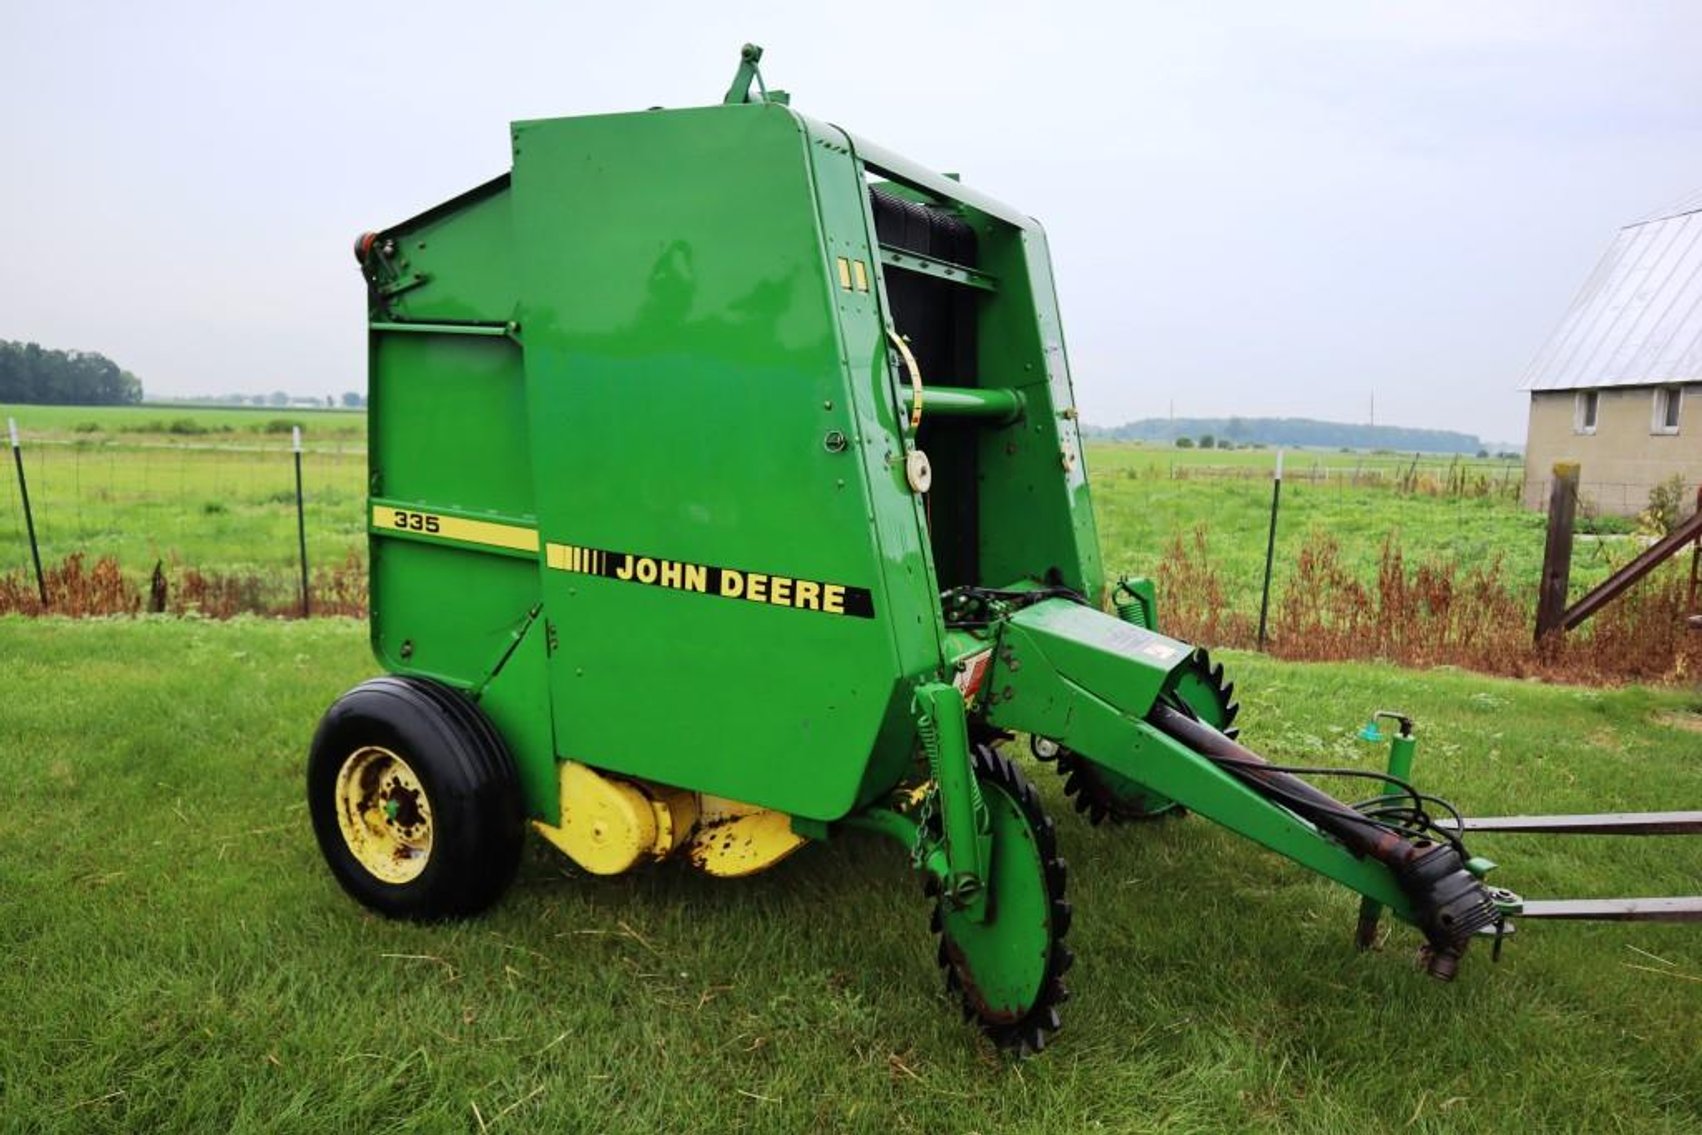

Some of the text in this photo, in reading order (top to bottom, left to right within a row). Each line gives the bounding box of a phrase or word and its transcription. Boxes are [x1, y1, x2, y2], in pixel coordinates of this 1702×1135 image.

[394, 512, 440, 533] 335
[616, 555, 846, 614] JOHN DEERE
